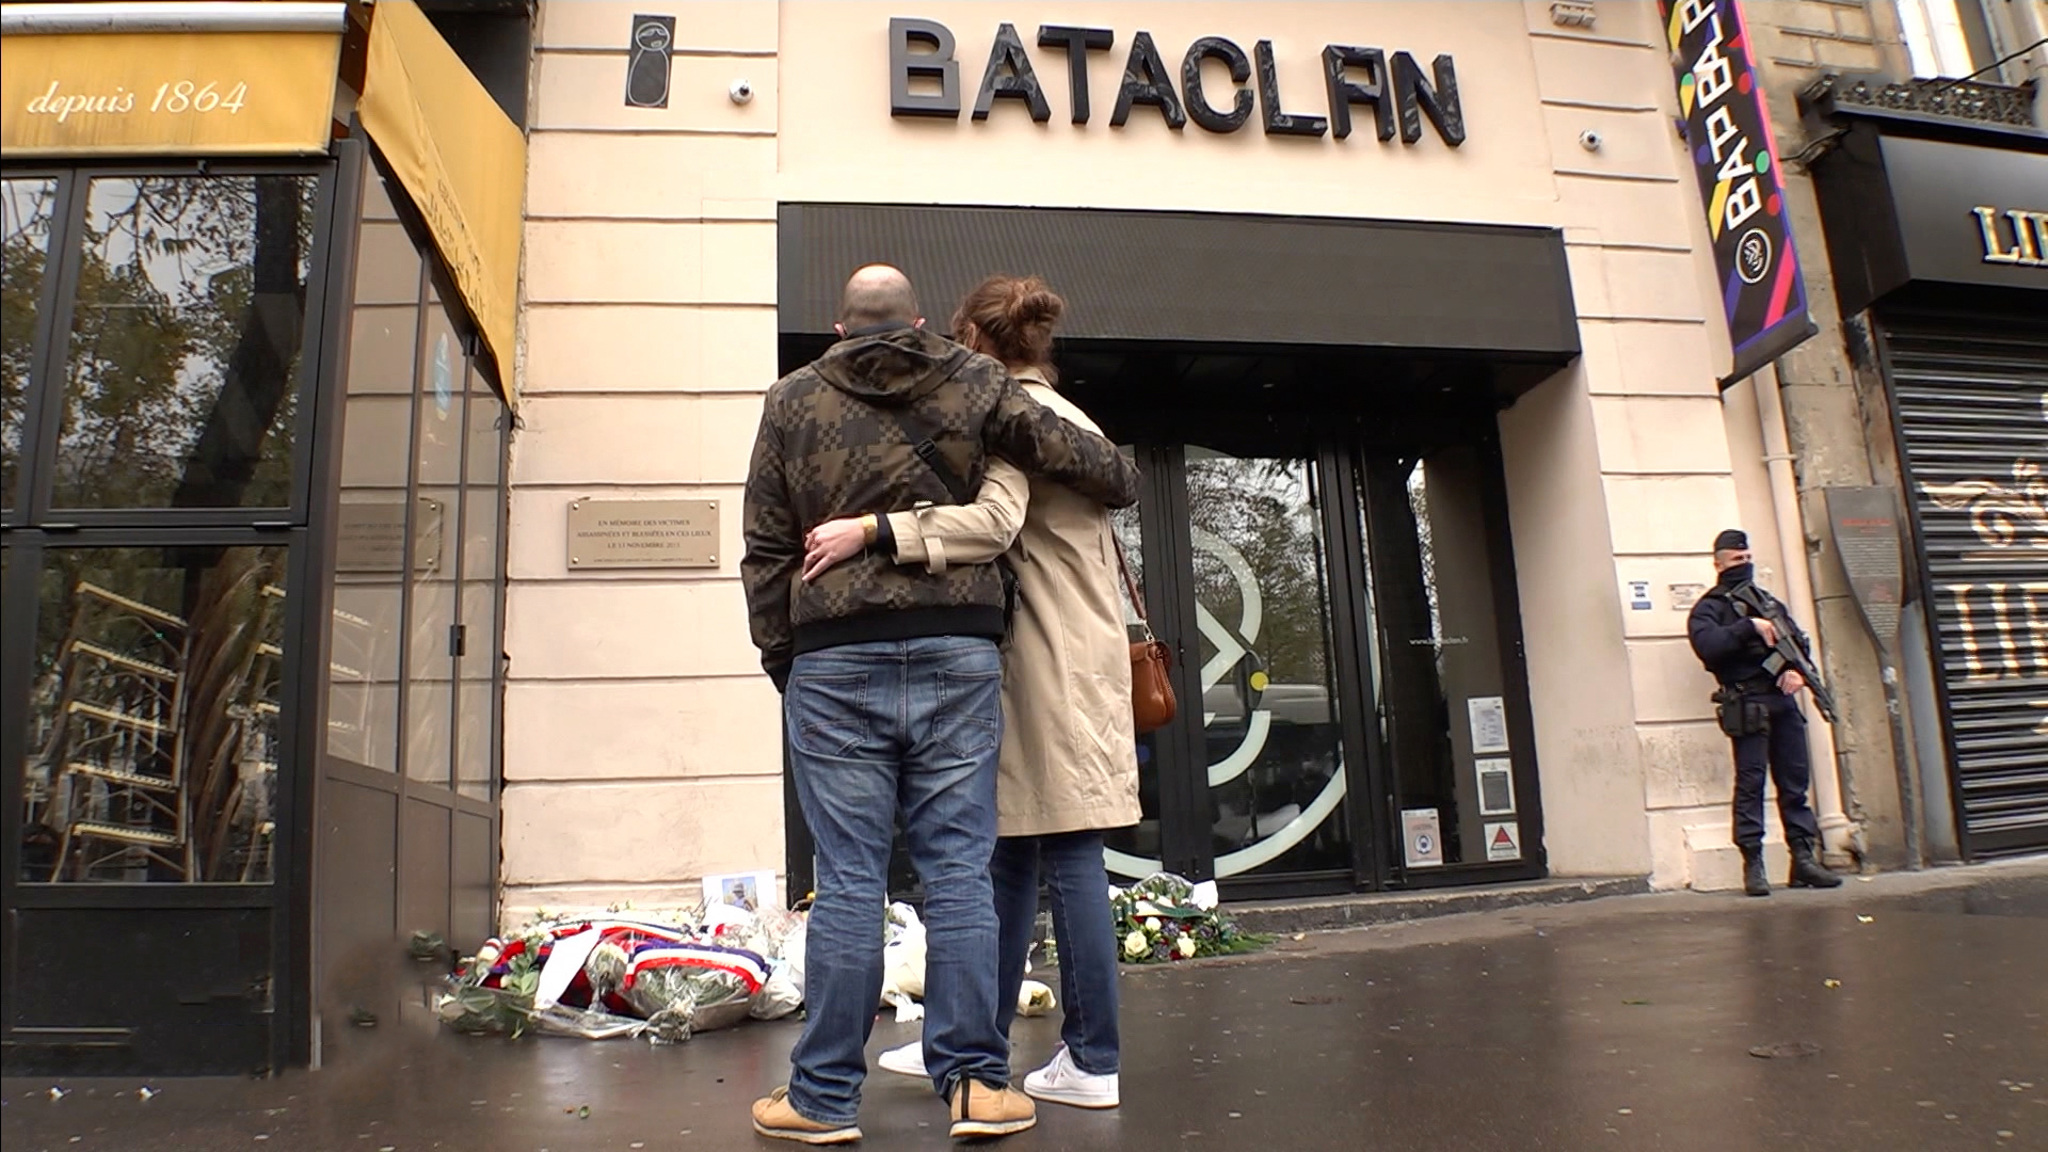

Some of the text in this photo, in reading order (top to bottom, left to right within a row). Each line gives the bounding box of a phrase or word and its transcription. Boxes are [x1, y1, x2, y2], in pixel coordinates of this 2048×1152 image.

[26, 80, 248, 123] depuis 1864
[889, 17, 1467, 148] BATACLAN
[658, 519, 691, 527] VICTIMES
